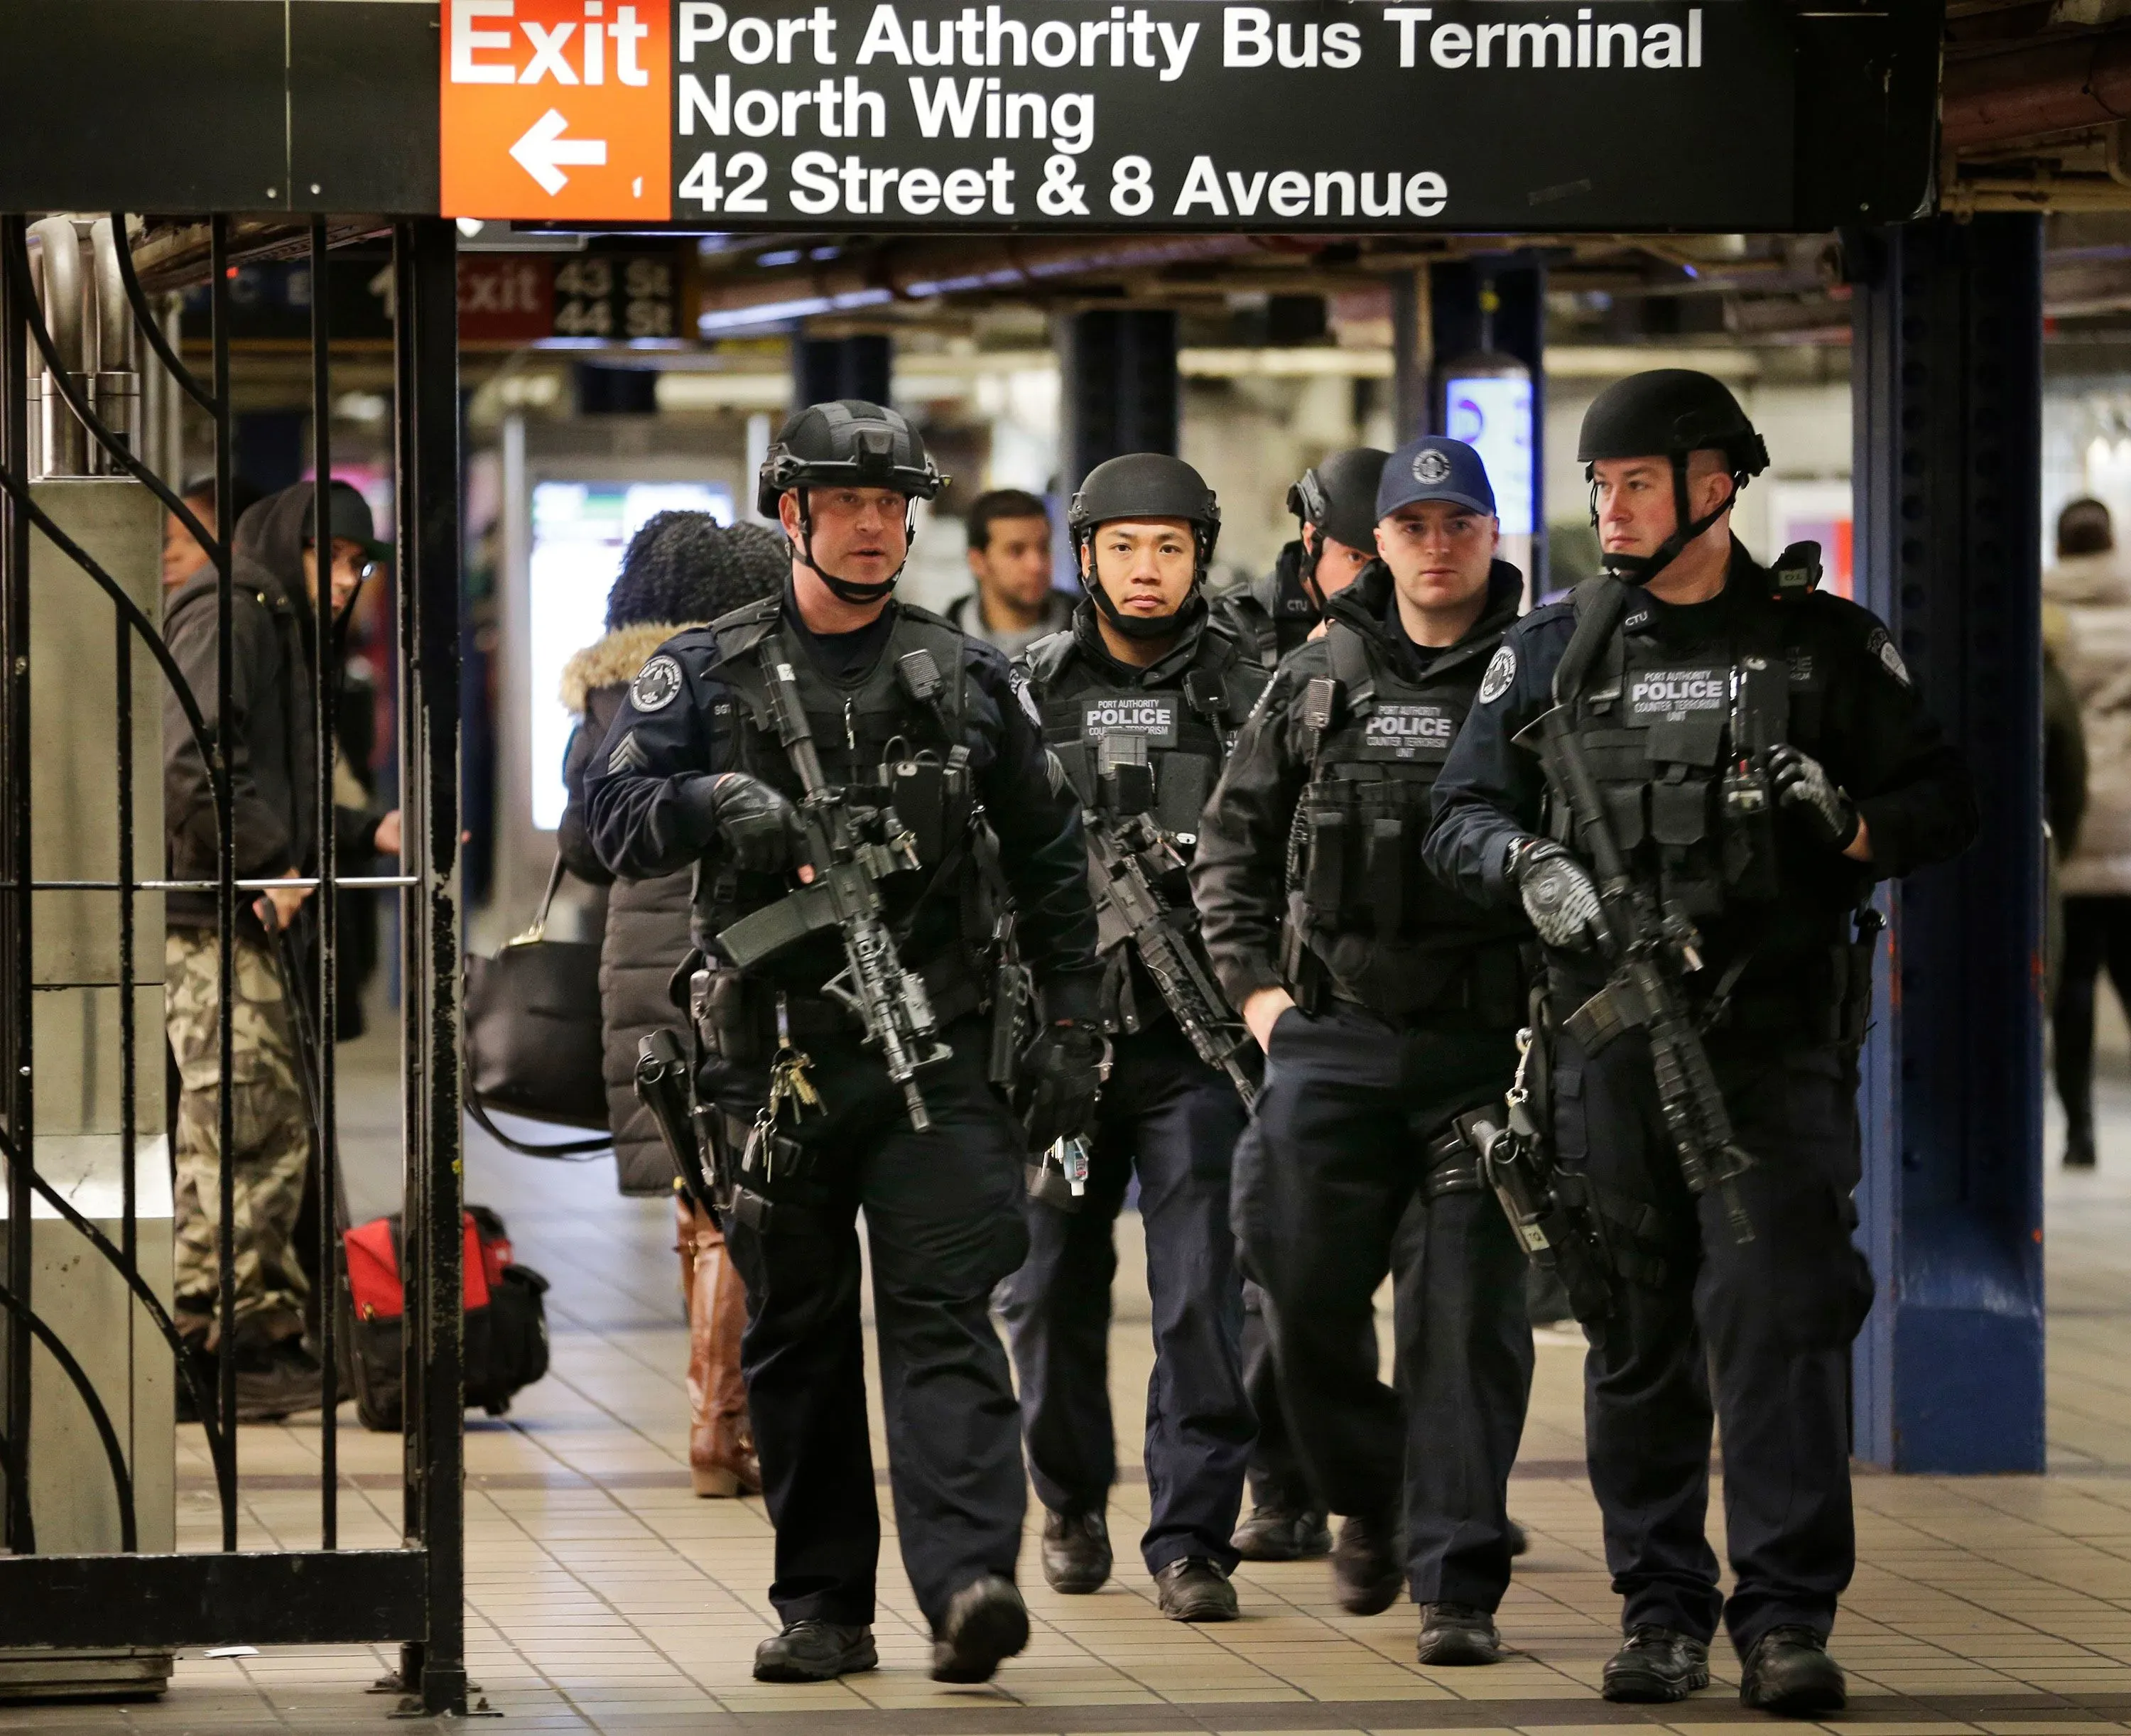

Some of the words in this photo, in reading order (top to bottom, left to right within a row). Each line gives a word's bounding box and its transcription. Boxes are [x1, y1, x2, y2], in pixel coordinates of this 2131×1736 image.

[450, 0, 649, 87] Exit
[678, 2, 837, 65] Port
[855, 4, 1200, 82] Authority
[1222, 7, 1362, 69] Bus
[1383, 8, 1702, 69] Terminal
[678, 73, 886, 138] North
[908, 75, 1095, 153] Wing
[678, 151, 769, 213] 42
[788, 150, 1016, 216] Street
[1036, 154, 1090, 216] &
[1110, 155, 1154, 217] 8
[1172, 155, 1448, 217] Avenue
[458, 259, 538, 312] xit
[1286, 600, 1308, 612] CTU
[1625, 611, 1648, 626] CTU
[1632, 680, 1723, 702] POLICE
[1098, 700, 1117, 709] PORT
[1117, 699, 1159, 708] AUTHORITY
[1086, 708, 1171, 726] POLICE
[1365, 717, 1453, 737] POLICE
